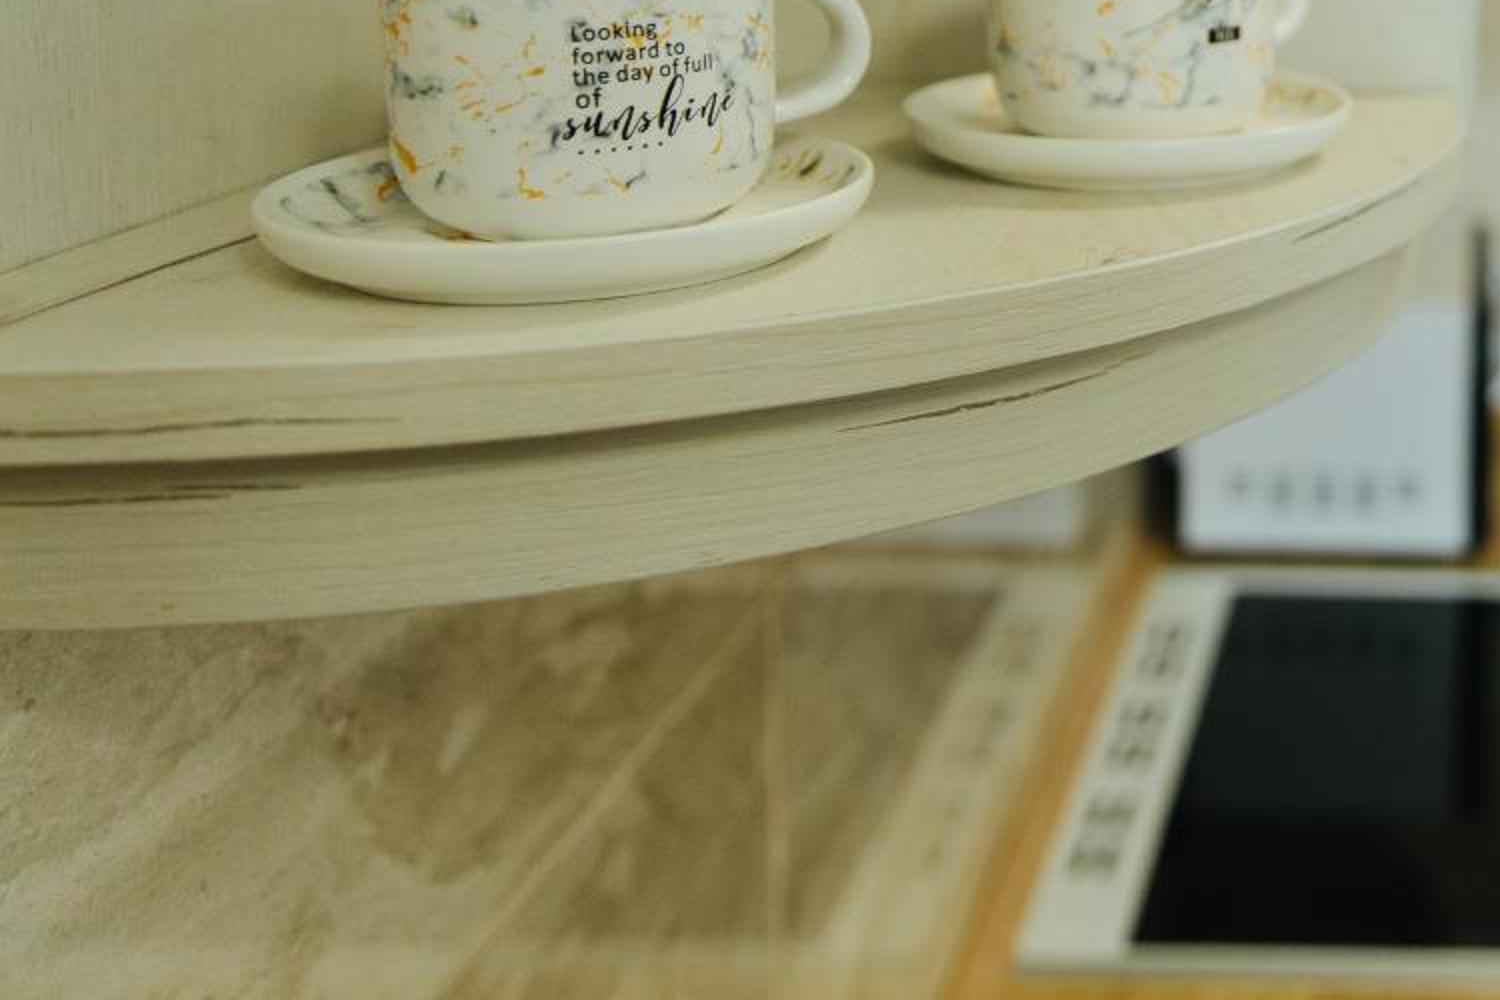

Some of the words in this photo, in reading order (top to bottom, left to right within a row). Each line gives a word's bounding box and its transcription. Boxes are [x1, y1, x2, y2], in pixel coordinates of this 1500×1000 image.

[571, 20, 657, 42] Looking
[573, 41, 659, 64] forward
[666, 41, 685, 56] to
[573, 68, 610, 86] the
[616, 64, 653, 83] day
[659, 58, 680, 77] of
[684, 53, 713, 73] full
[562, 74, 735, 141] sunshine
[575, 88, 602, 109] of
